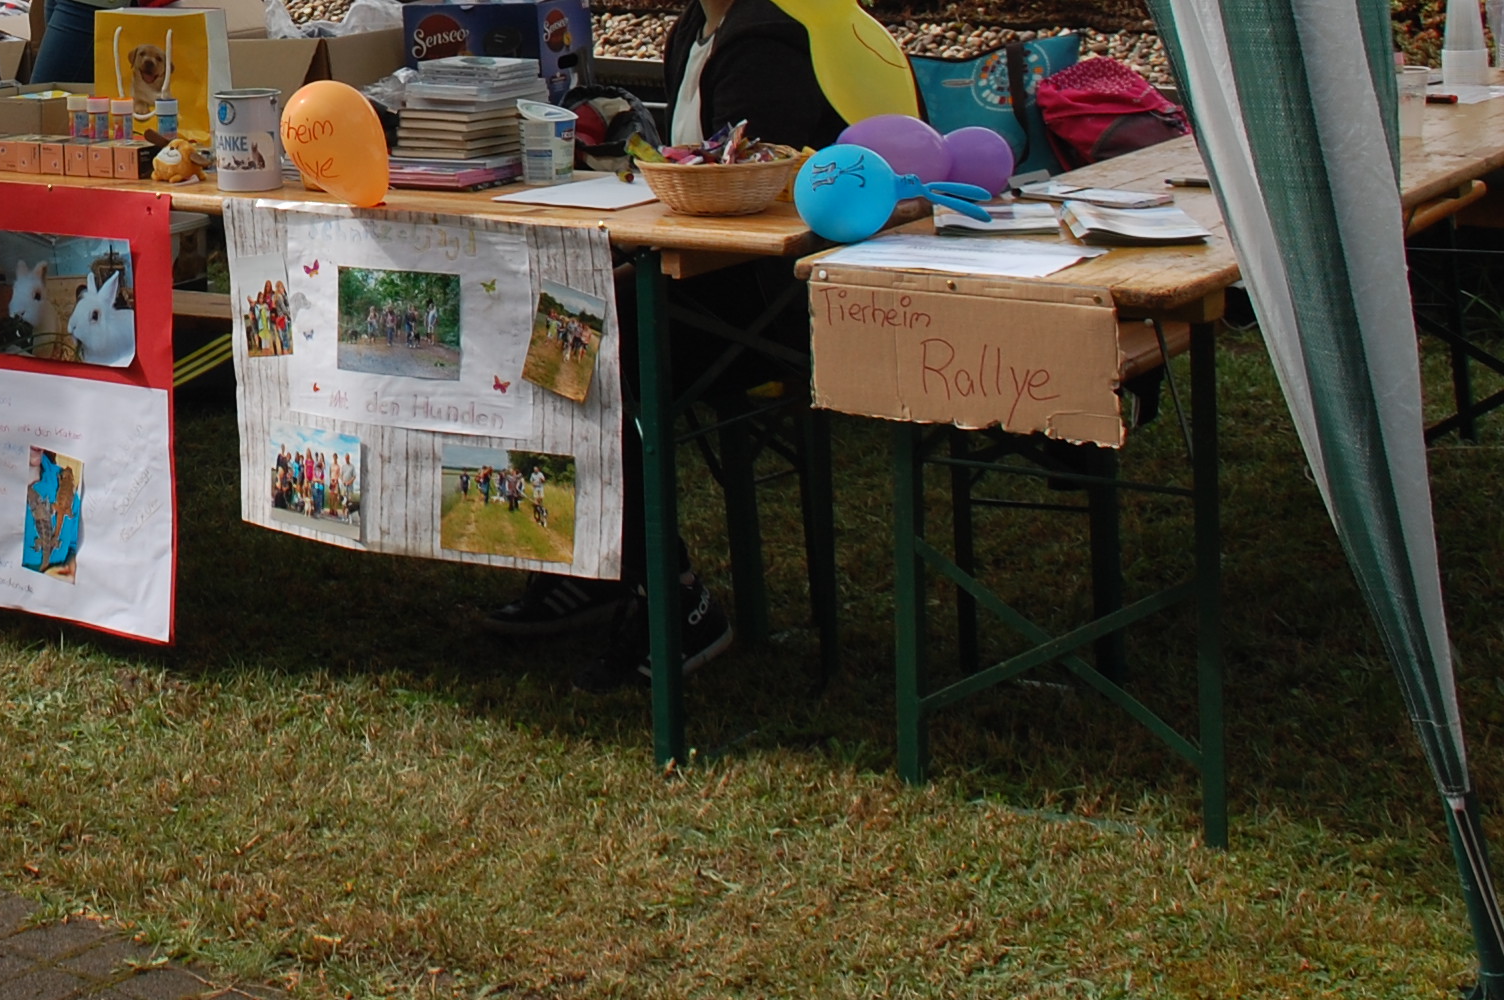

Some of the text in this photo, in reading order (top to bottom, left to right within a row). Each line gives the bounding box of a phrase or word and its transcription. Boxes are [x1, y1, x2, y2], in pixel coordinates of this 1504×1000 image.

[411, 27, 470, 60] Senseo
[543, 16, 569, 42] Senseo
[818, 286, 932, 329] Tierheim
[920, 338, 1060, 428] Rallye
[365, 391, 400, 417] den
[412, 394, 504, 430] Hunden
